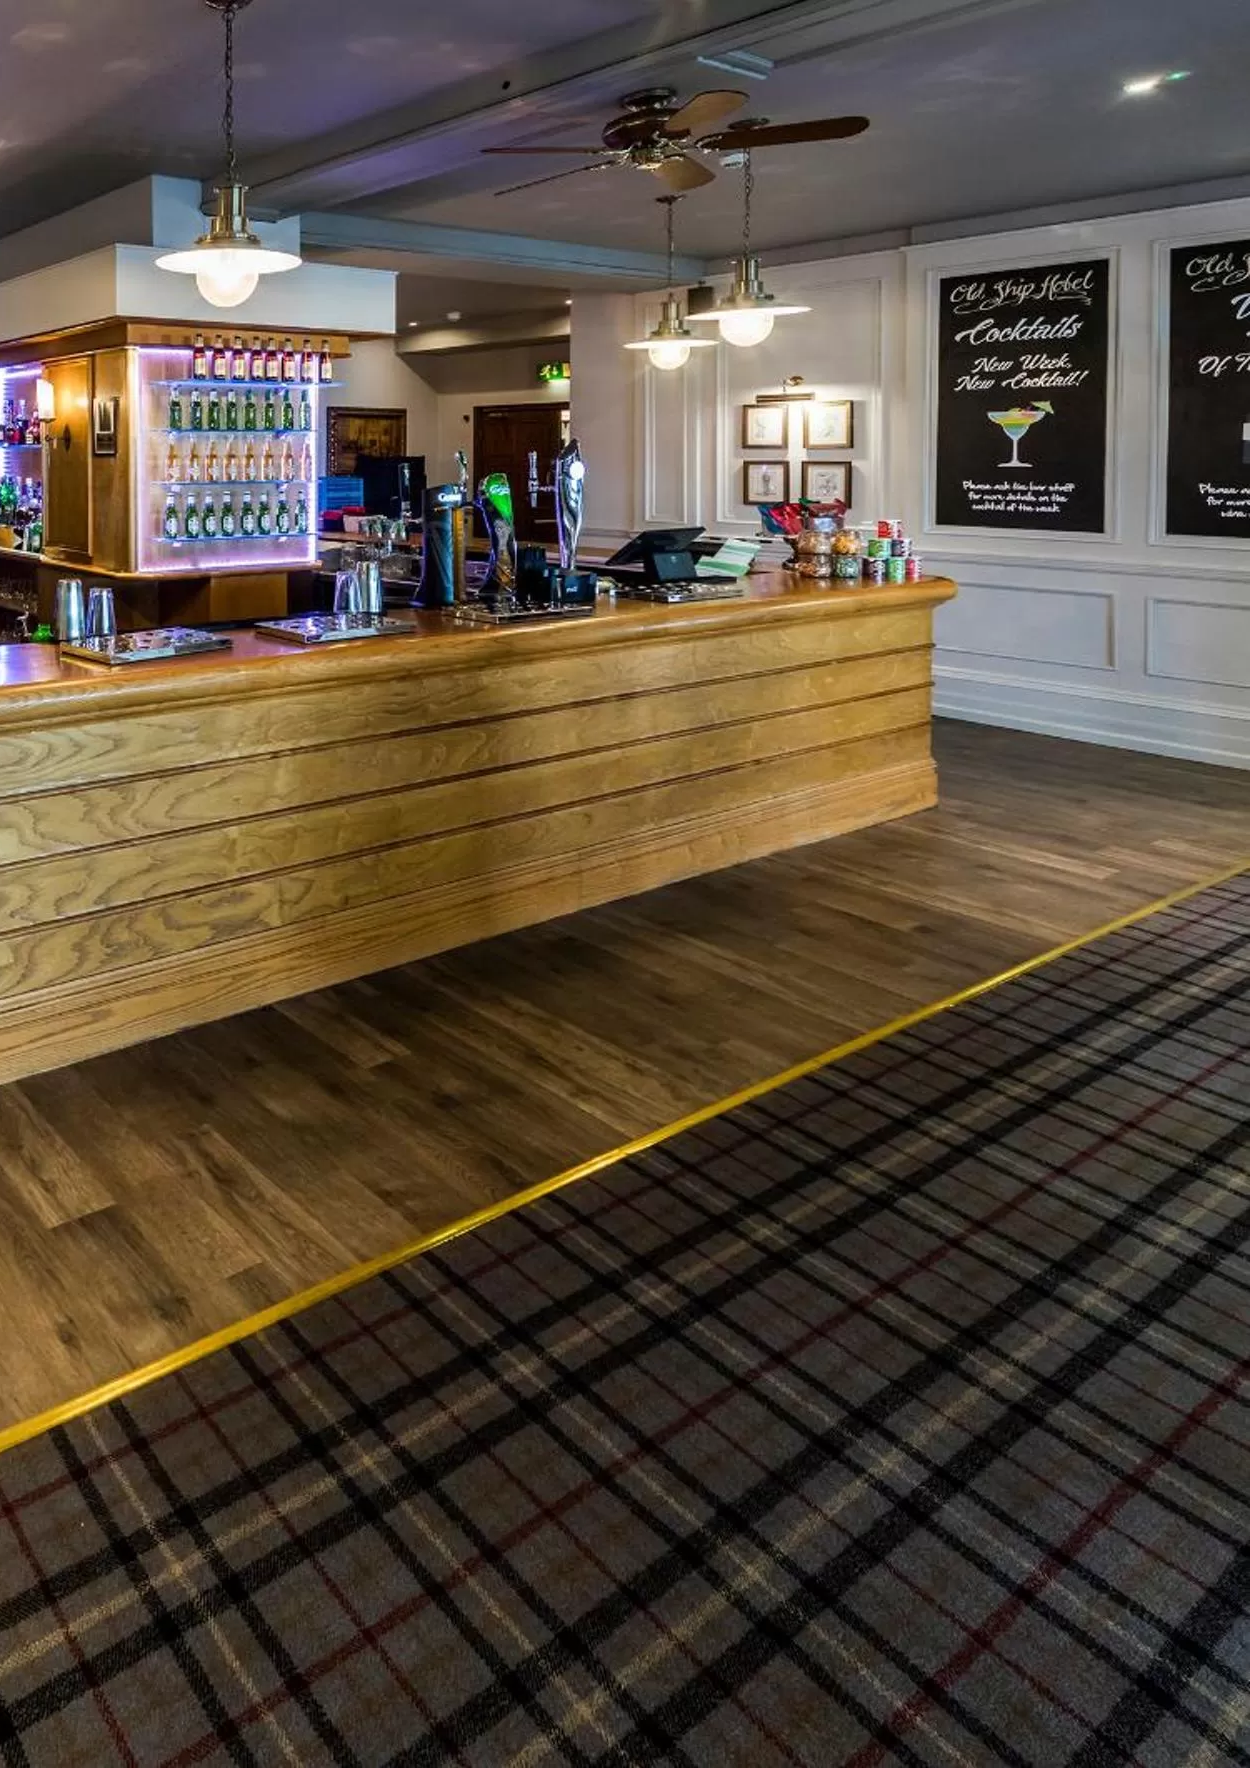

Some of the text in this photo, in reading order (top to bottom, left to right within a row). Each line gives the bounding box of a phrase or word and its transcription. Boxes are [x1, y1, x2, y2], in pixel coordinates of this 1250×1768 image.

[1185, 252, 1234, 276] Old
[950, 269, 1094, 306] Old Ship Hotel
[954, 314, 1084, 346] Cocktails
[971, 356, 1014, 374] New
[1197, 355, 1232, 378] Of
[954, 370, 1089, 391] New Cocktail!
[1206, 496, 1224, 506] for
